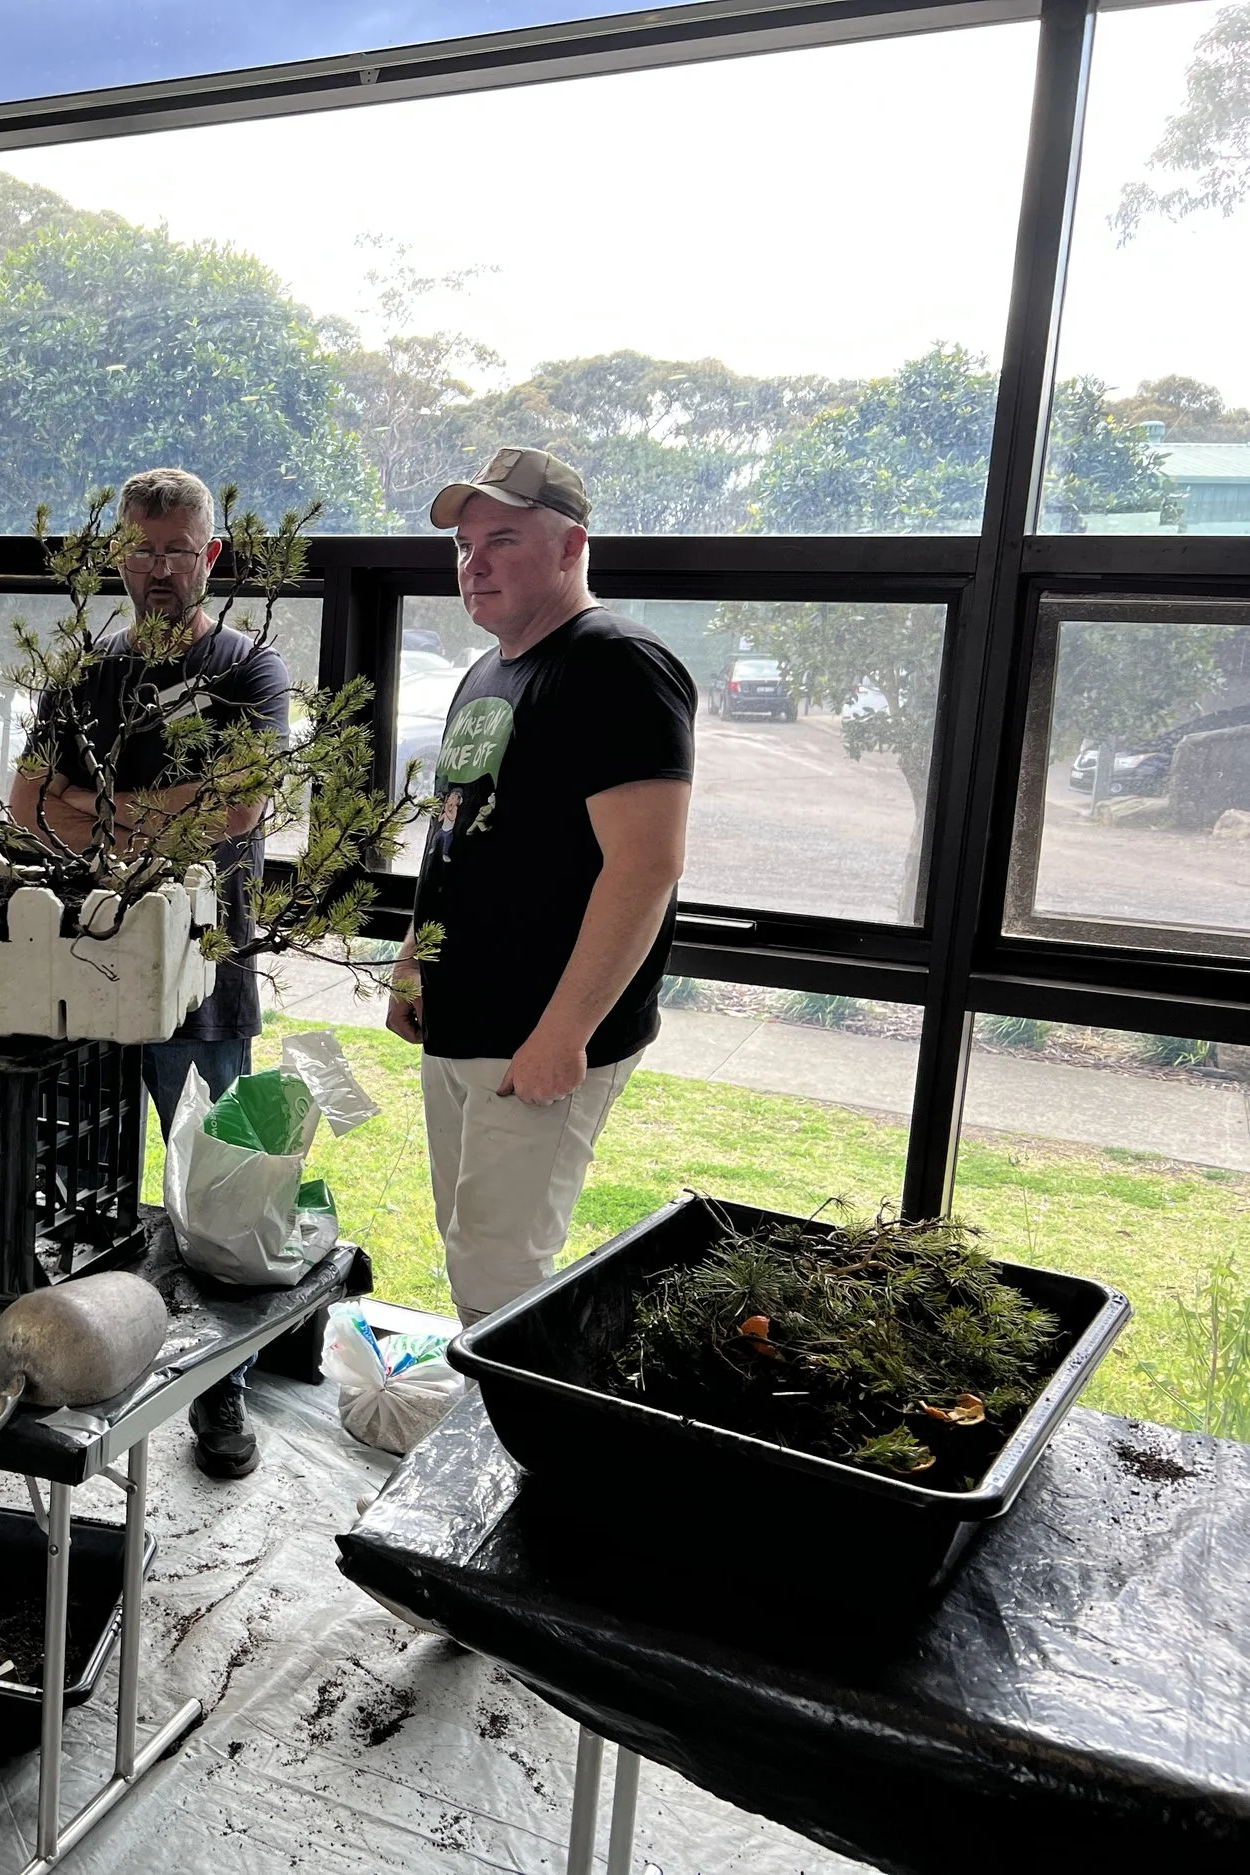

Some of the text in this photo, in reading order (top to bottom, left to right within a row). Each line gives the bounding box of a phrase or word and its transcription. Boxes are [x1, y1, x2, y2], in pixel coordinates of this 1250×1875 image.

[452, 707, 507, 740] WIRE ON
[437, 738, 498, 770] WIRE OFF
